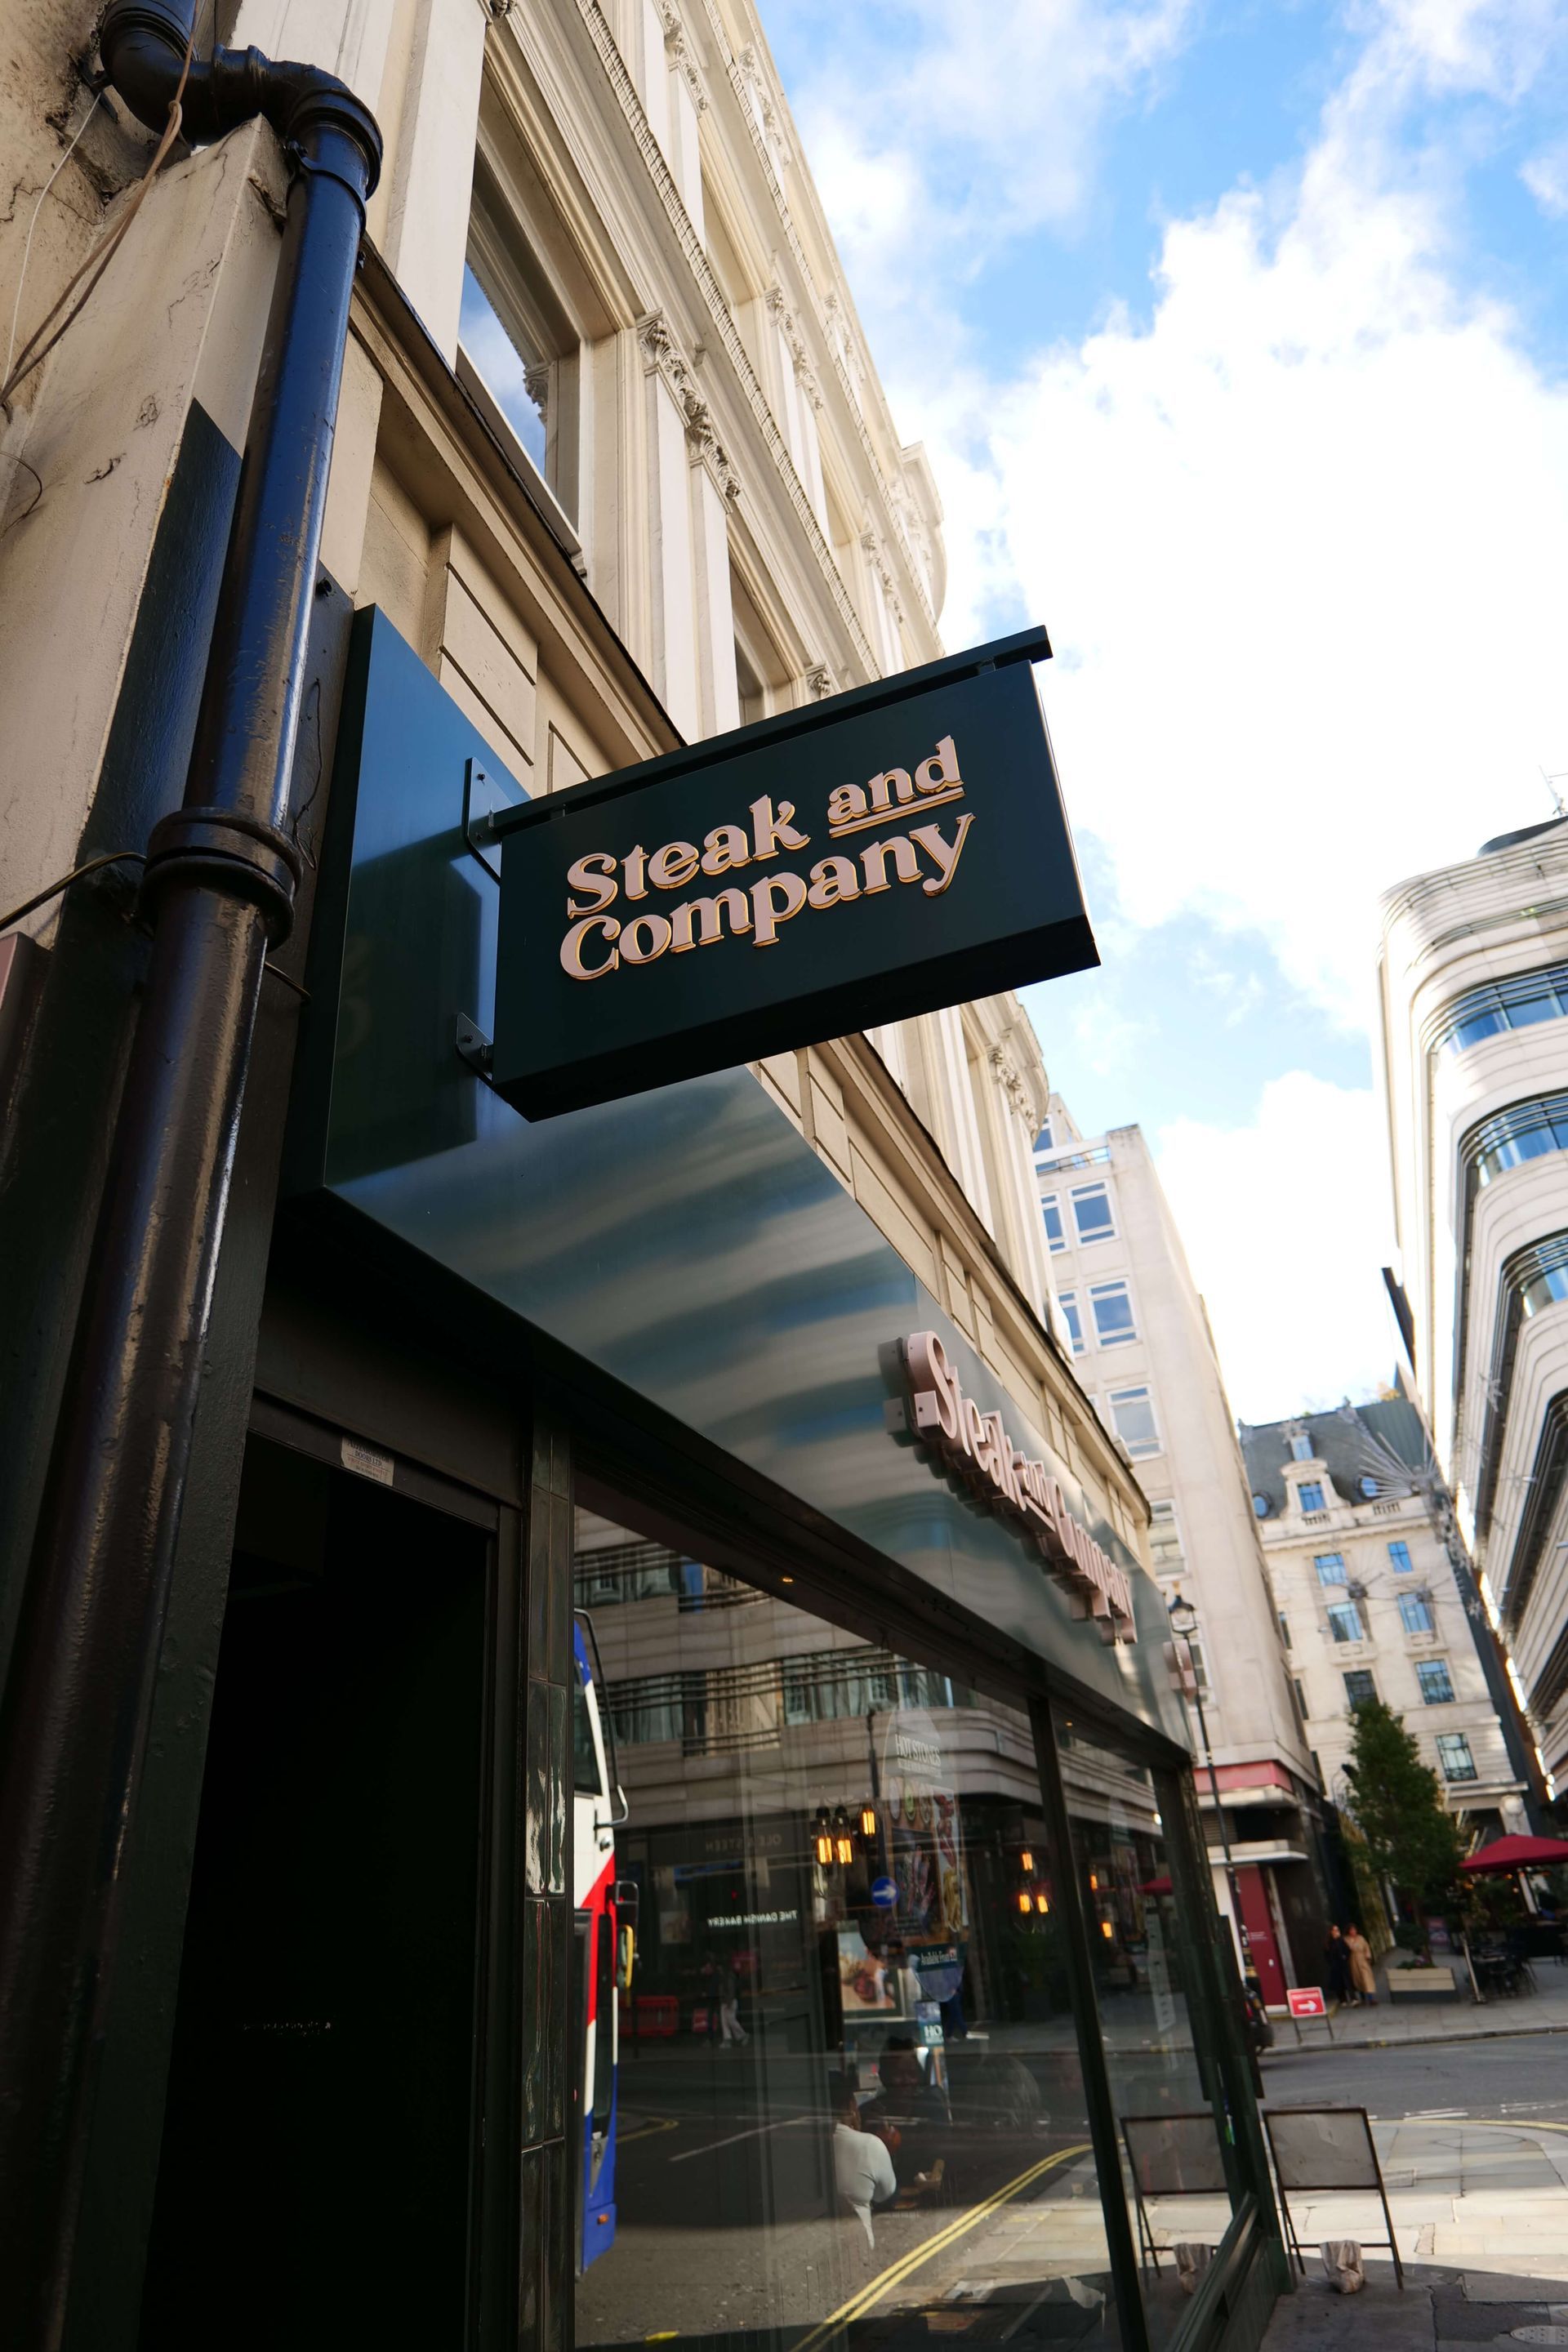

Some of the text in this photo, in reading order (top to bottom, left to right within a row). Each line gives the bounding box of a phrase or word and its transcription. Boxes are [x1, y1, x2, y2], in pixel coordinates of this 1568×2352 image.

[559, 812, 976, 980] Company
[567, 735, 964, 919] Steak and
[354, 1450, 372, 1463] DOORS
[907, 1330, 1027, 1512] Steak
[895, 1734, 942, 1768] HOT STONES
